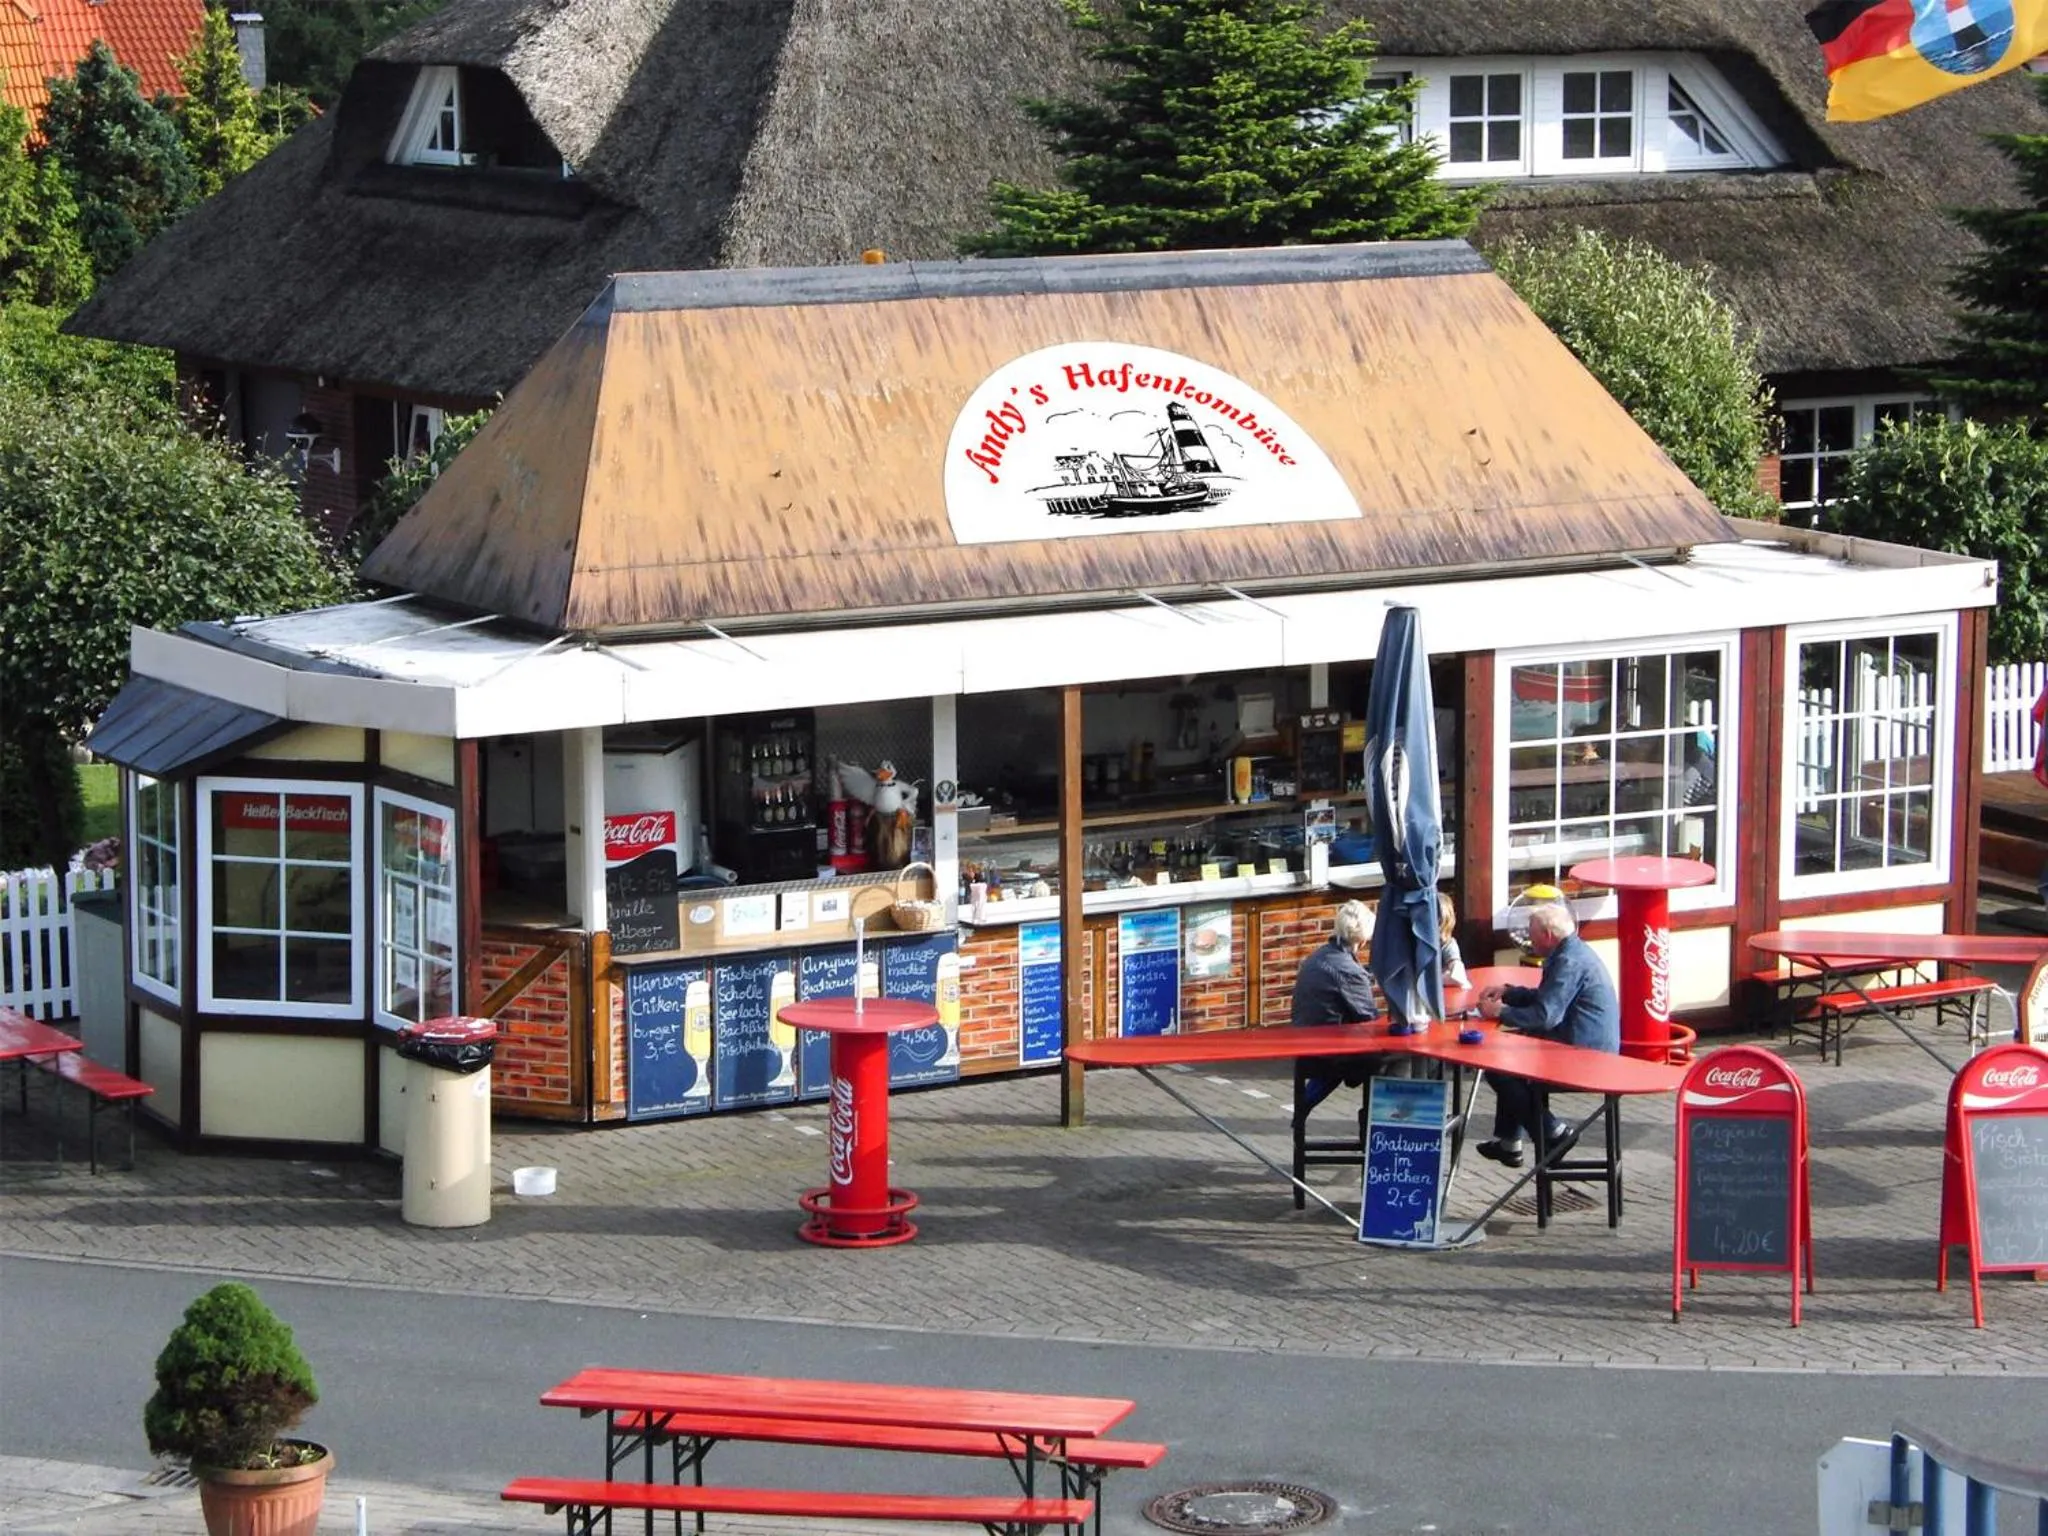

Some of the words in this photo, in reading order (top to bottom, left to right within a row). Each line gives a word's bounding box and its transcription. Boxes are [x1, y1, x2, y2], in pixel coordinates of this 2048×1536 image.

[965, 384, 1049, 484] Andy's
[1061, 362, 1297, 467] Hafenkombüse
[286, 804, 348, 822] Backfisch
[611, 923, 663, 941] rdbeer
[802, 950, 875, 977] Currywust
[1644, 923, 1669, 1021] Coca-Cola
[632, 971, 701, 996] Hamburger
[719, 984, 764, 1003] Scholle
[633, 1023, 680, 1042] burger
[902, 1029, 938, 1045] 4,50€
[1705, 1067, 1762, 1087] Coca-Cola
[1982, 1067, 2040, 1088] Coca-Cola
[831, 1077, 853, 1185] Coca-Cola
[1370, 1131, 1441, 1155] Bratwurst
[1394, 1153, 1412, 1168] im
[1369, 1166, 1432, 1186] Brötchen
